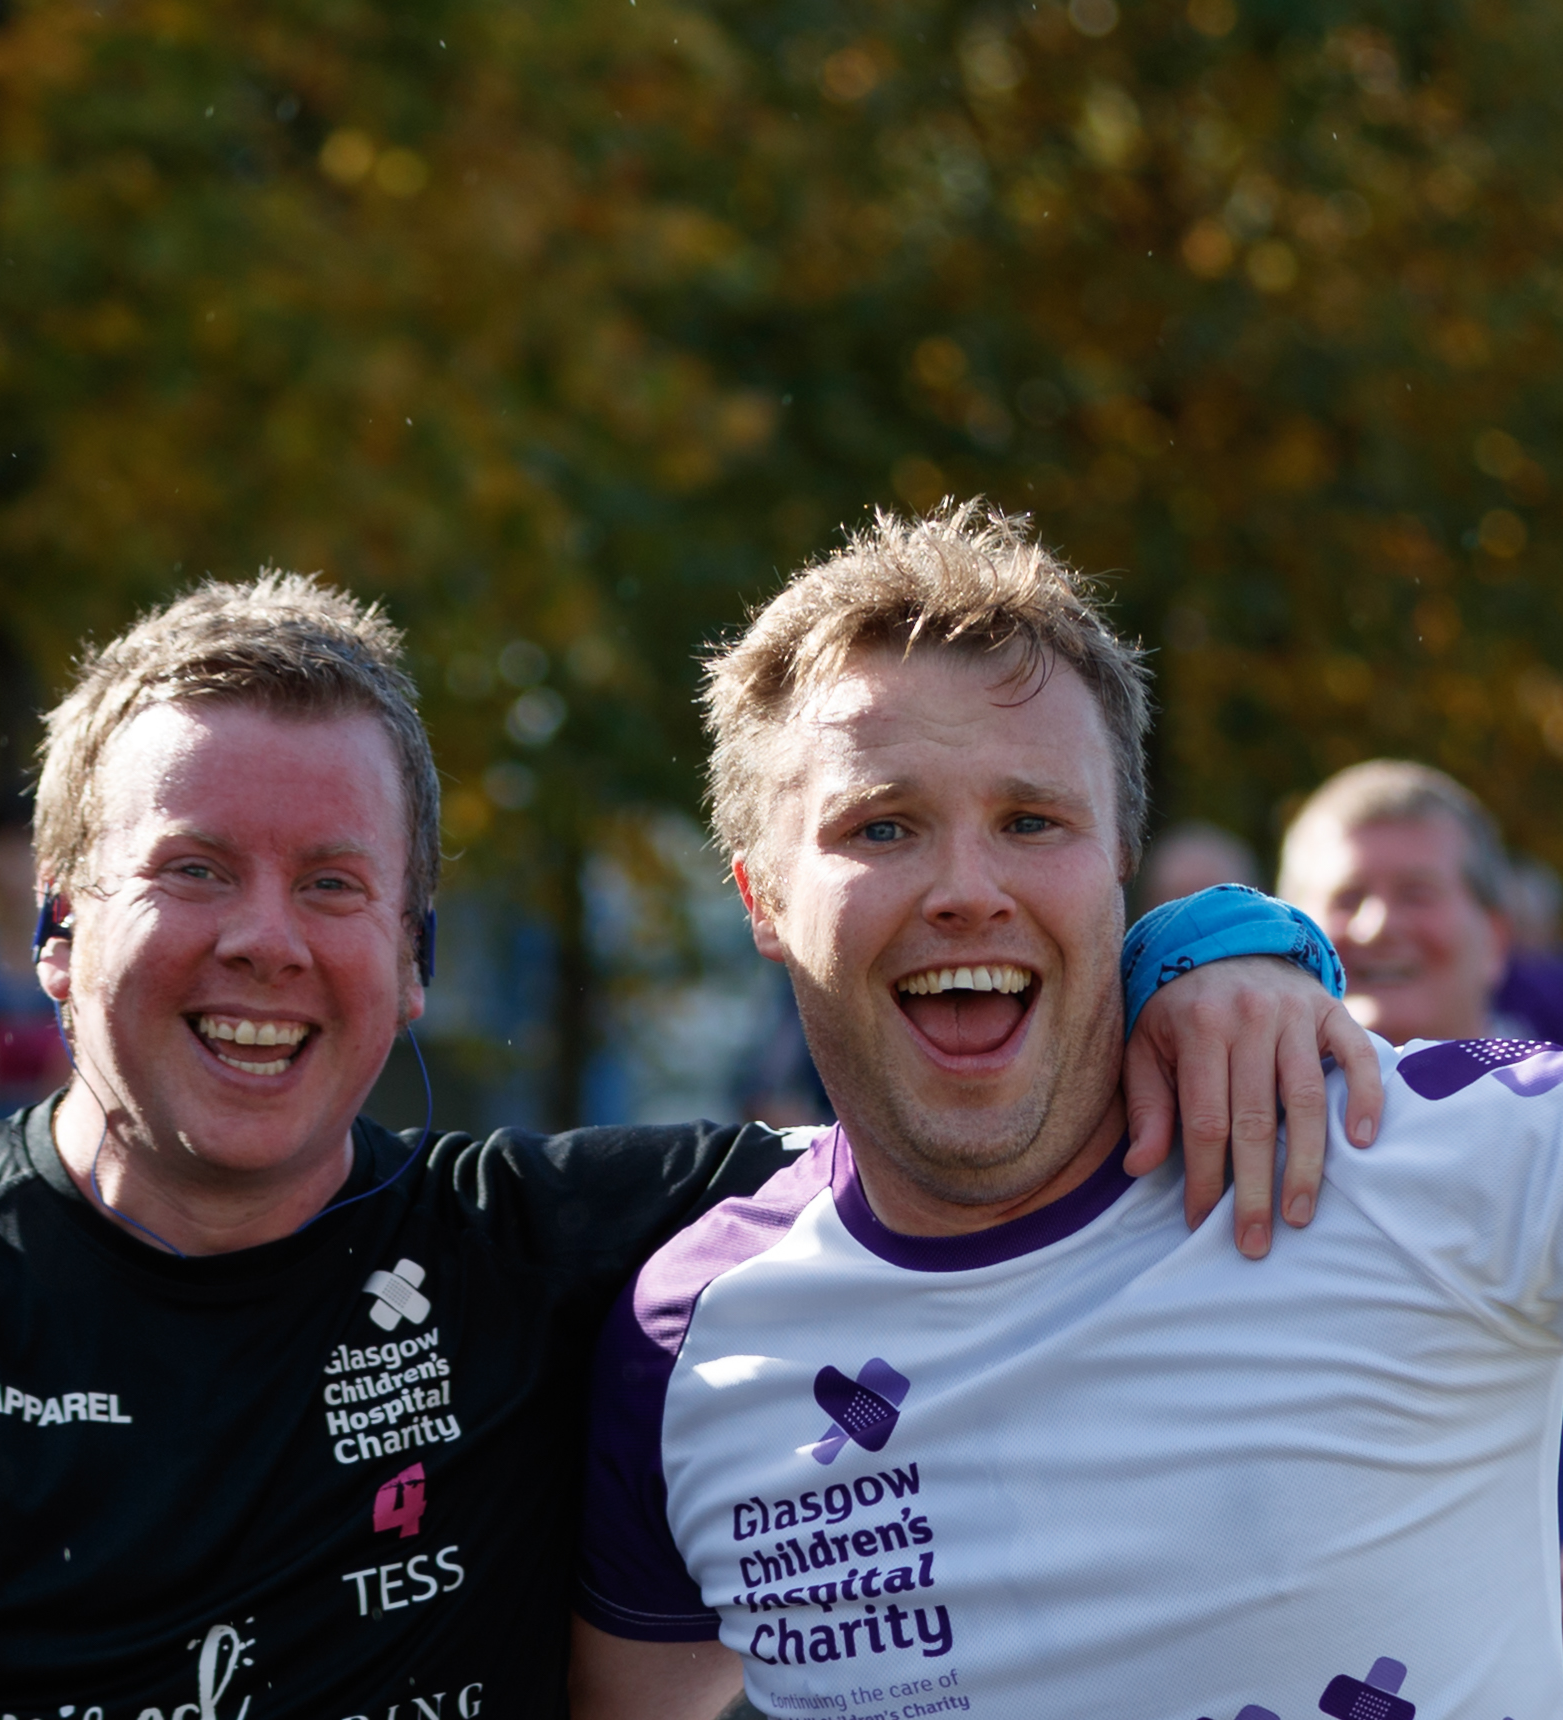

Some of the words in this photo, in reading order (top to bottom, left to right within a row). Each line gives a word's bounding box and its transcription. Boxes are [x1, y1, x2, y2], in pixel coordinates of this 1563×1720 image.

[324, 1328, 439, 1374] Glasgow
[324, 1352, 451, 1405] Children's
[326, 1380, 451, 1436] Hospital
[334, 1413, 462, 1464] Charity
[373, 1461, 427, 1538] 4
[733, 1462, 920, 1541] Glasgow
[740, 1507, 934, 1588] Children's
[342, 1545, 465, 1616] TESS
[750, 1604, 953, 1666] Charity
[770, 1691, 848, 1712] Continuing
[850, 1686, 883, 1705] the
[889, 1678, 933, 1698] care
[938, 1668, 959, 1688] of
[902, 1695, 971, 1720] Charity
